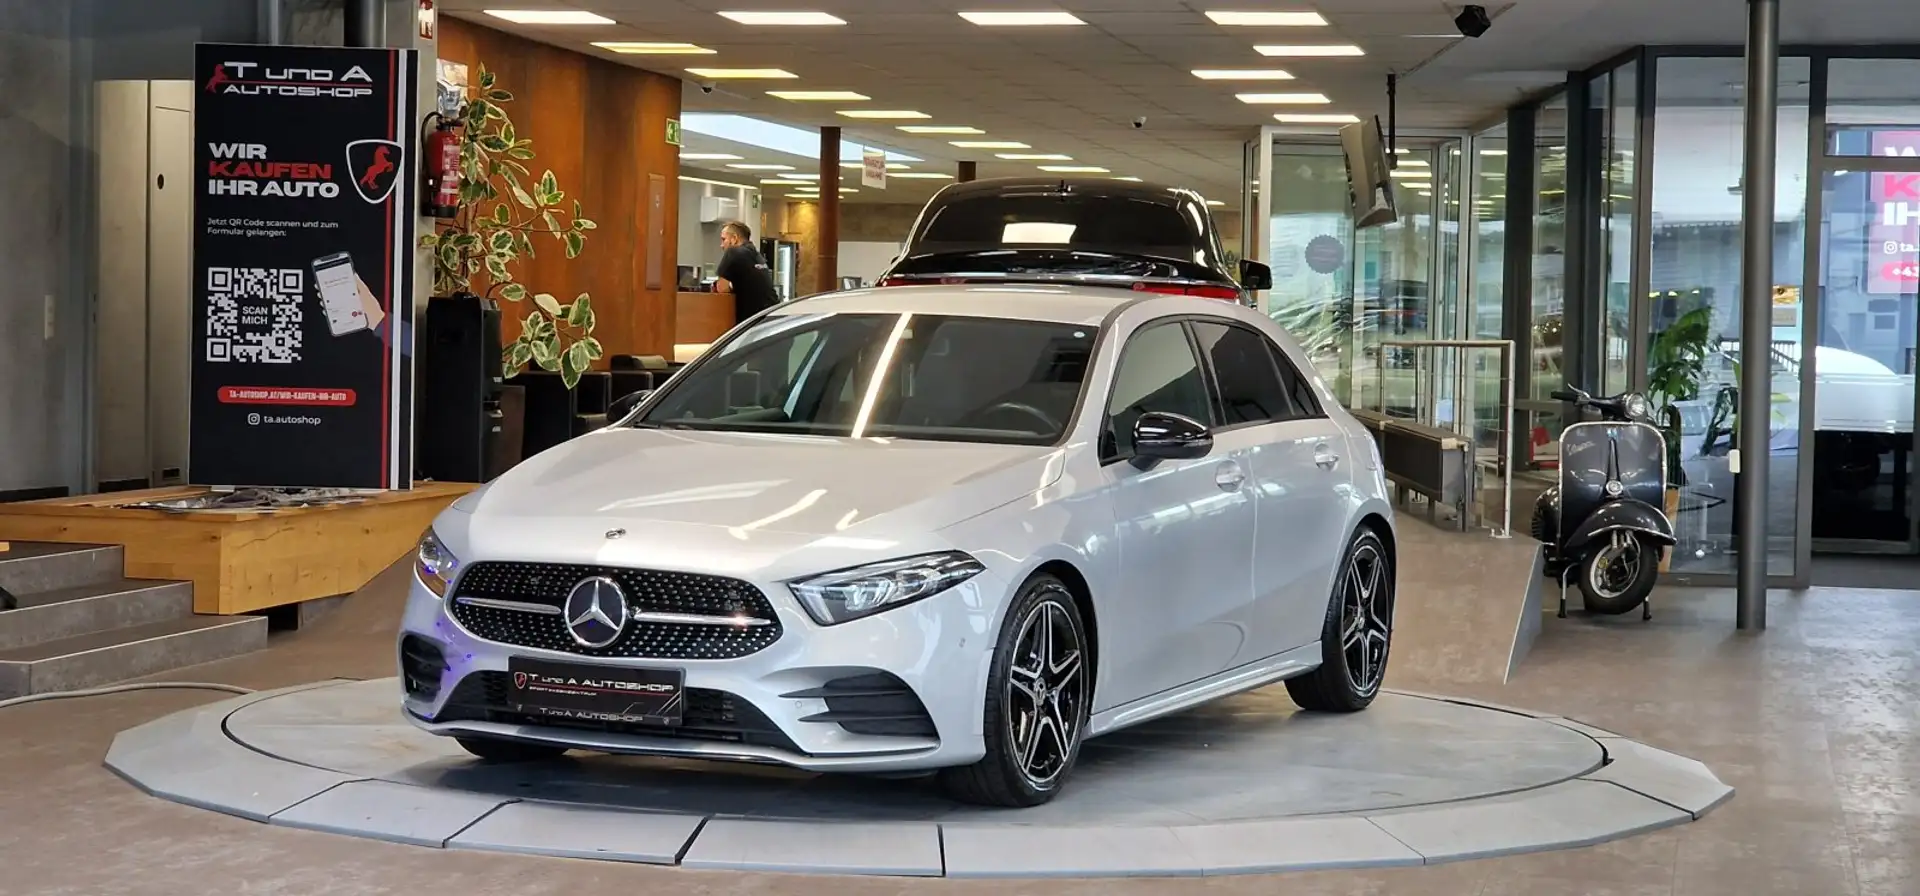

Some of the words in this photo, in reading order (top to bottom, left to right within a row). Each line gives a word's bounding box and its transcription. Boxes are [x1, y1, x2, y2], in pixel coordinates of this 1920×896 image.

[224, 61, 258, 78] T
[340, 65, 373, 82] A
[223, 84, 373, 98] AUTOSHOP
[208, 142, 267, 159] WIR
[208, 161, 332, 179] KAUFEN
[208, 179, 258, 196] IHR
[261, 182, 340, 198] AUTO
[207, 217, 228, 226] Jetzt
[228, 218, 242, 227] QR
[243, 218, 264, 227] Code
[266, 220, 300, 228] scannen
[302, 220, 319, 228] und
[320, 221, 339, 229] zum
[207, 226, 244, 236] Formular
[246, 228, 287, 237] gelangen:
[242, 306, 268, 315] SCAN
[242, 315, 268, 325] MICH
[263, 415, 322, 426] ta.autoshop
[528, 673, 539, 681] T
[567, 677, 578, 686] A
[582, 679, 674, 692] AUTOSHOP
[576, 712, 643, 722] AUTOSHOP
